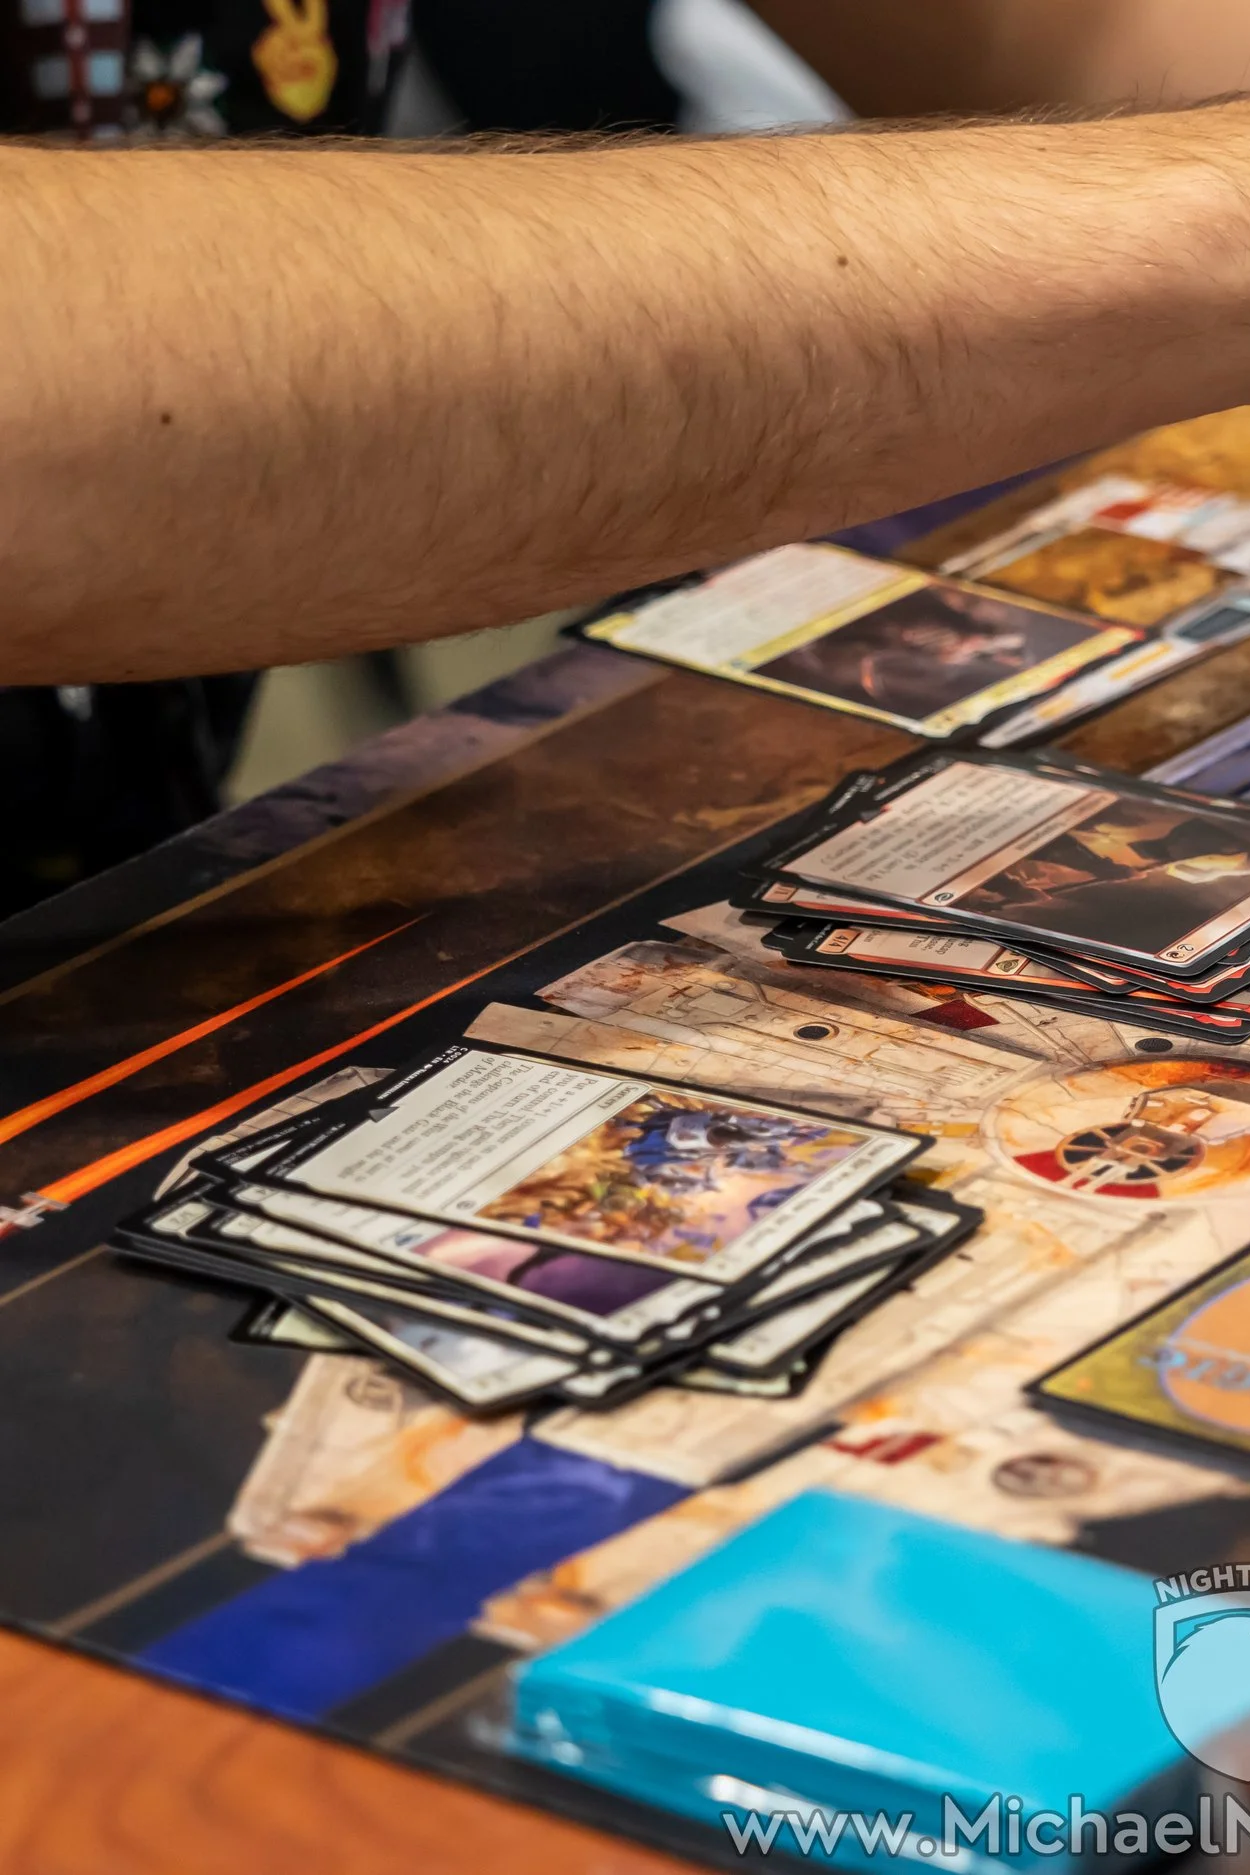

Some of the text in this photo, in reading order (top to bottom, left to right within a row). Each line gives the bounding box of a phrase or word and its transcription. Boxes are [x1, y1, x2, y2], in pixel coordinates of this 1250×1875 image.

[442, 1056, 500, 1090] of Mordor.
[464, 1060, 519, 1089] challenge
[506, 1063, 536, 1077] The
[536, 1070, 565, 1084] end
[524, 1083, 546, 1092] of
[551, 1073, 581, 1087] you
[571, 1077, 599, 1090] Put
[452, 1088, 477, 1099] the
[461, 1075, 518, 1105] Captains
[594, 1085, 640, 1110] Sorcery
[422, 1098, 462, 1119] Black
[451, 1104, 475, 1113] of
[478, 1108, 510, 1124] The
[438, 1112, 464, 1123] the
[488, 1112, 527, 1131] They
[397, 1118, 433, 1135] Gate
